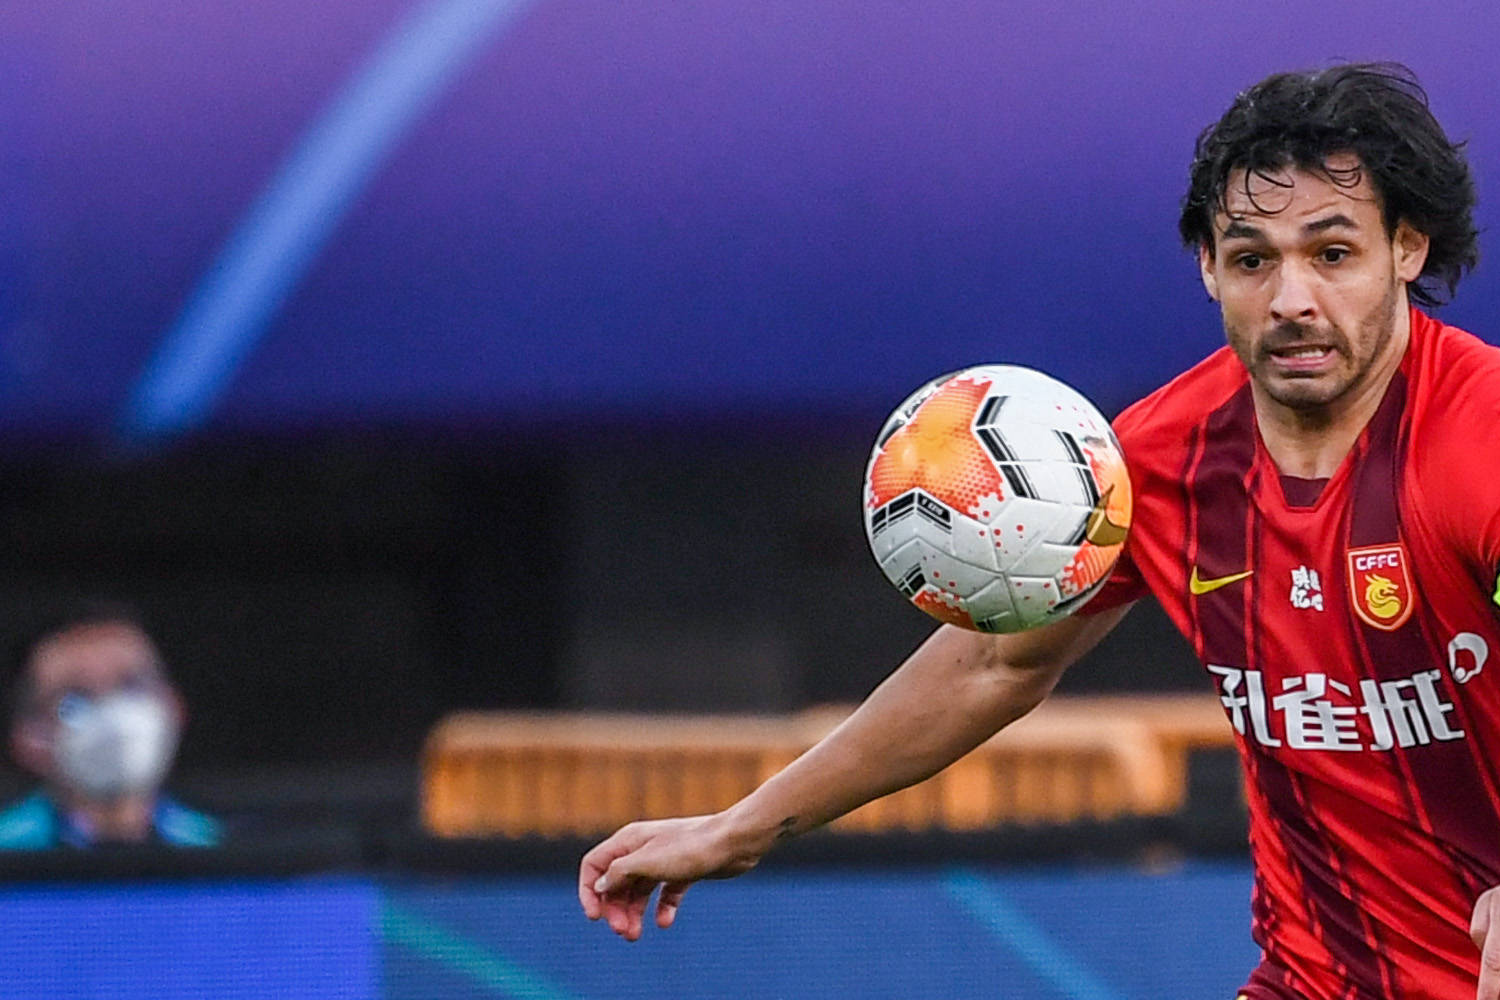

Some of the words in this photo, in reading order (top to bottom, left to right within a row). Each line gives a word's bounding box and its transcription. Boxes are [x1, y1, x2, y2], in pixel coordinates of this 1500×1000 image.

[1356, 553, 1399, 571] CFFC
[1206, 663, 1466, 752] 孔雀城
